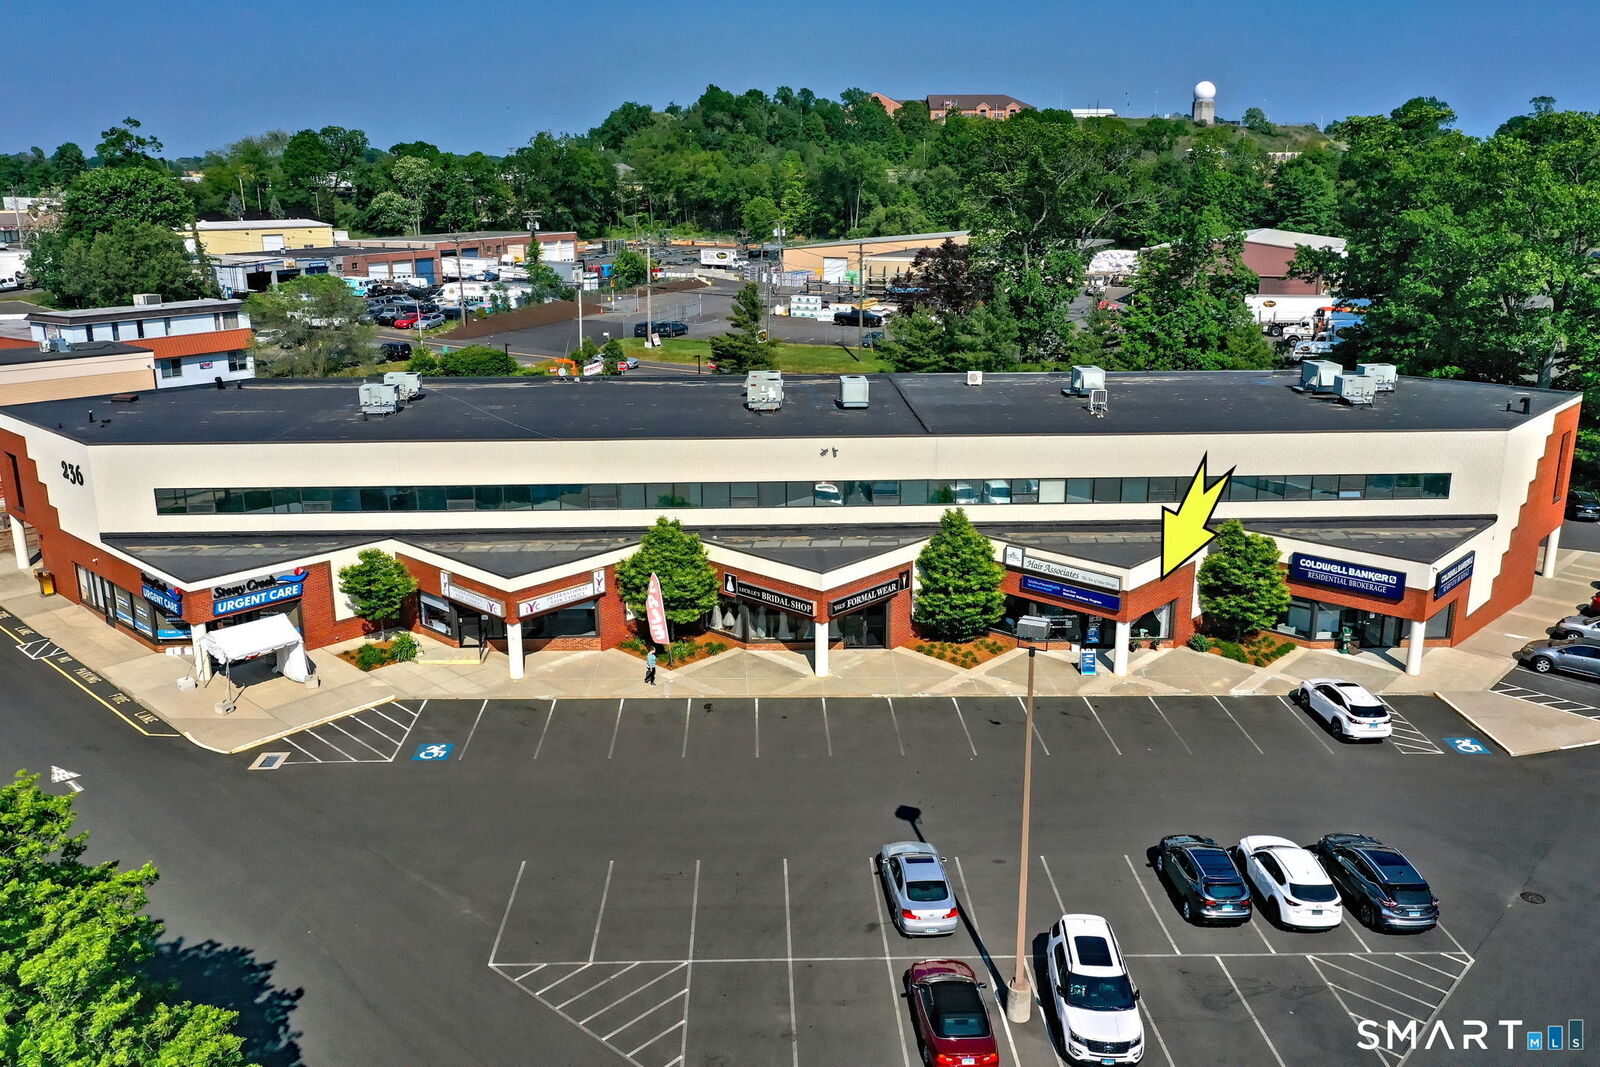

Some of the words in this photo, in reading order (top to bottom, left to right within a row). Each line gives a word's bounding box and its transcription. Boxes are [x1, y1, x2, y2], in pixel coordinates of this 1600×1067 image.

[61, 460, 84, 486] 236
[1026, 560, 1043, 571] Hair
[1044, 564, 1080, 580] Associates
[1300, 558, 1347, 575] COLDWELL
[1348, 567, 1389, 583] BANKER
[1307, 571, 1348, 586] RESIDENTIAL
[1348, 579, 1387, 594] BROKERAGE
[214, 584, 246, 599] Stony
[246, 575, 277, 592] Creek
[217, 595, 265, 613] URGENT
[265, 584, 298, 601] CARE
[847, 592, 877, 608] FORMAL
[876, 583, 898, 598] WEAR
[142, 587, 163, 606] URGENT
[163, 598, 178, 614] CARE
[761, 591, 790, 606] BRIDAL
[790, 599, 812, 613] SHOP
